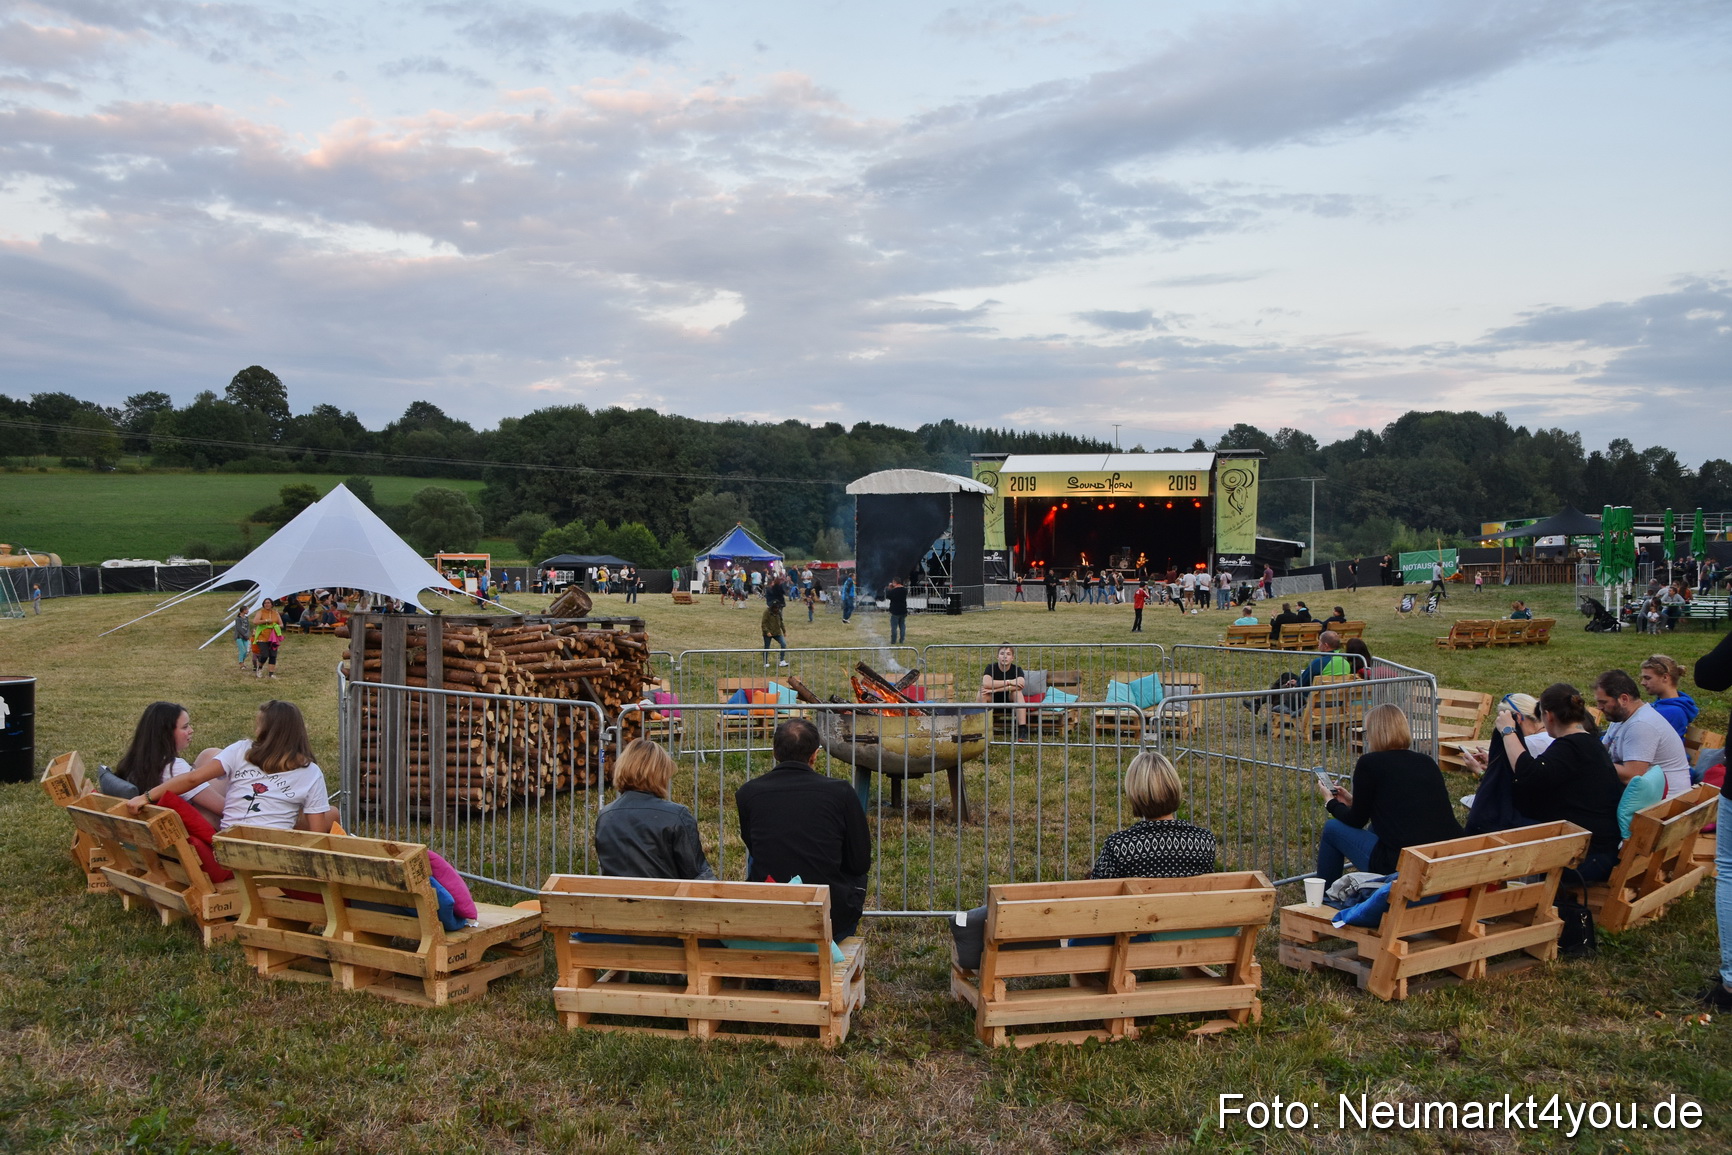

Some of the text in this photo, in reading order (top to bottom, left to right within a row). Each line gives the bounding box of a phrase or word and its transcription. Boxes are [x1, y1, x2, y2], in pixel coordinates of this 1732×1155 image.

[1010, 476, 1037, 491] 2019
[1168, 475, 1197, 491] 2019
[1402, 561, 1454, 571] NOTAUSGNG
